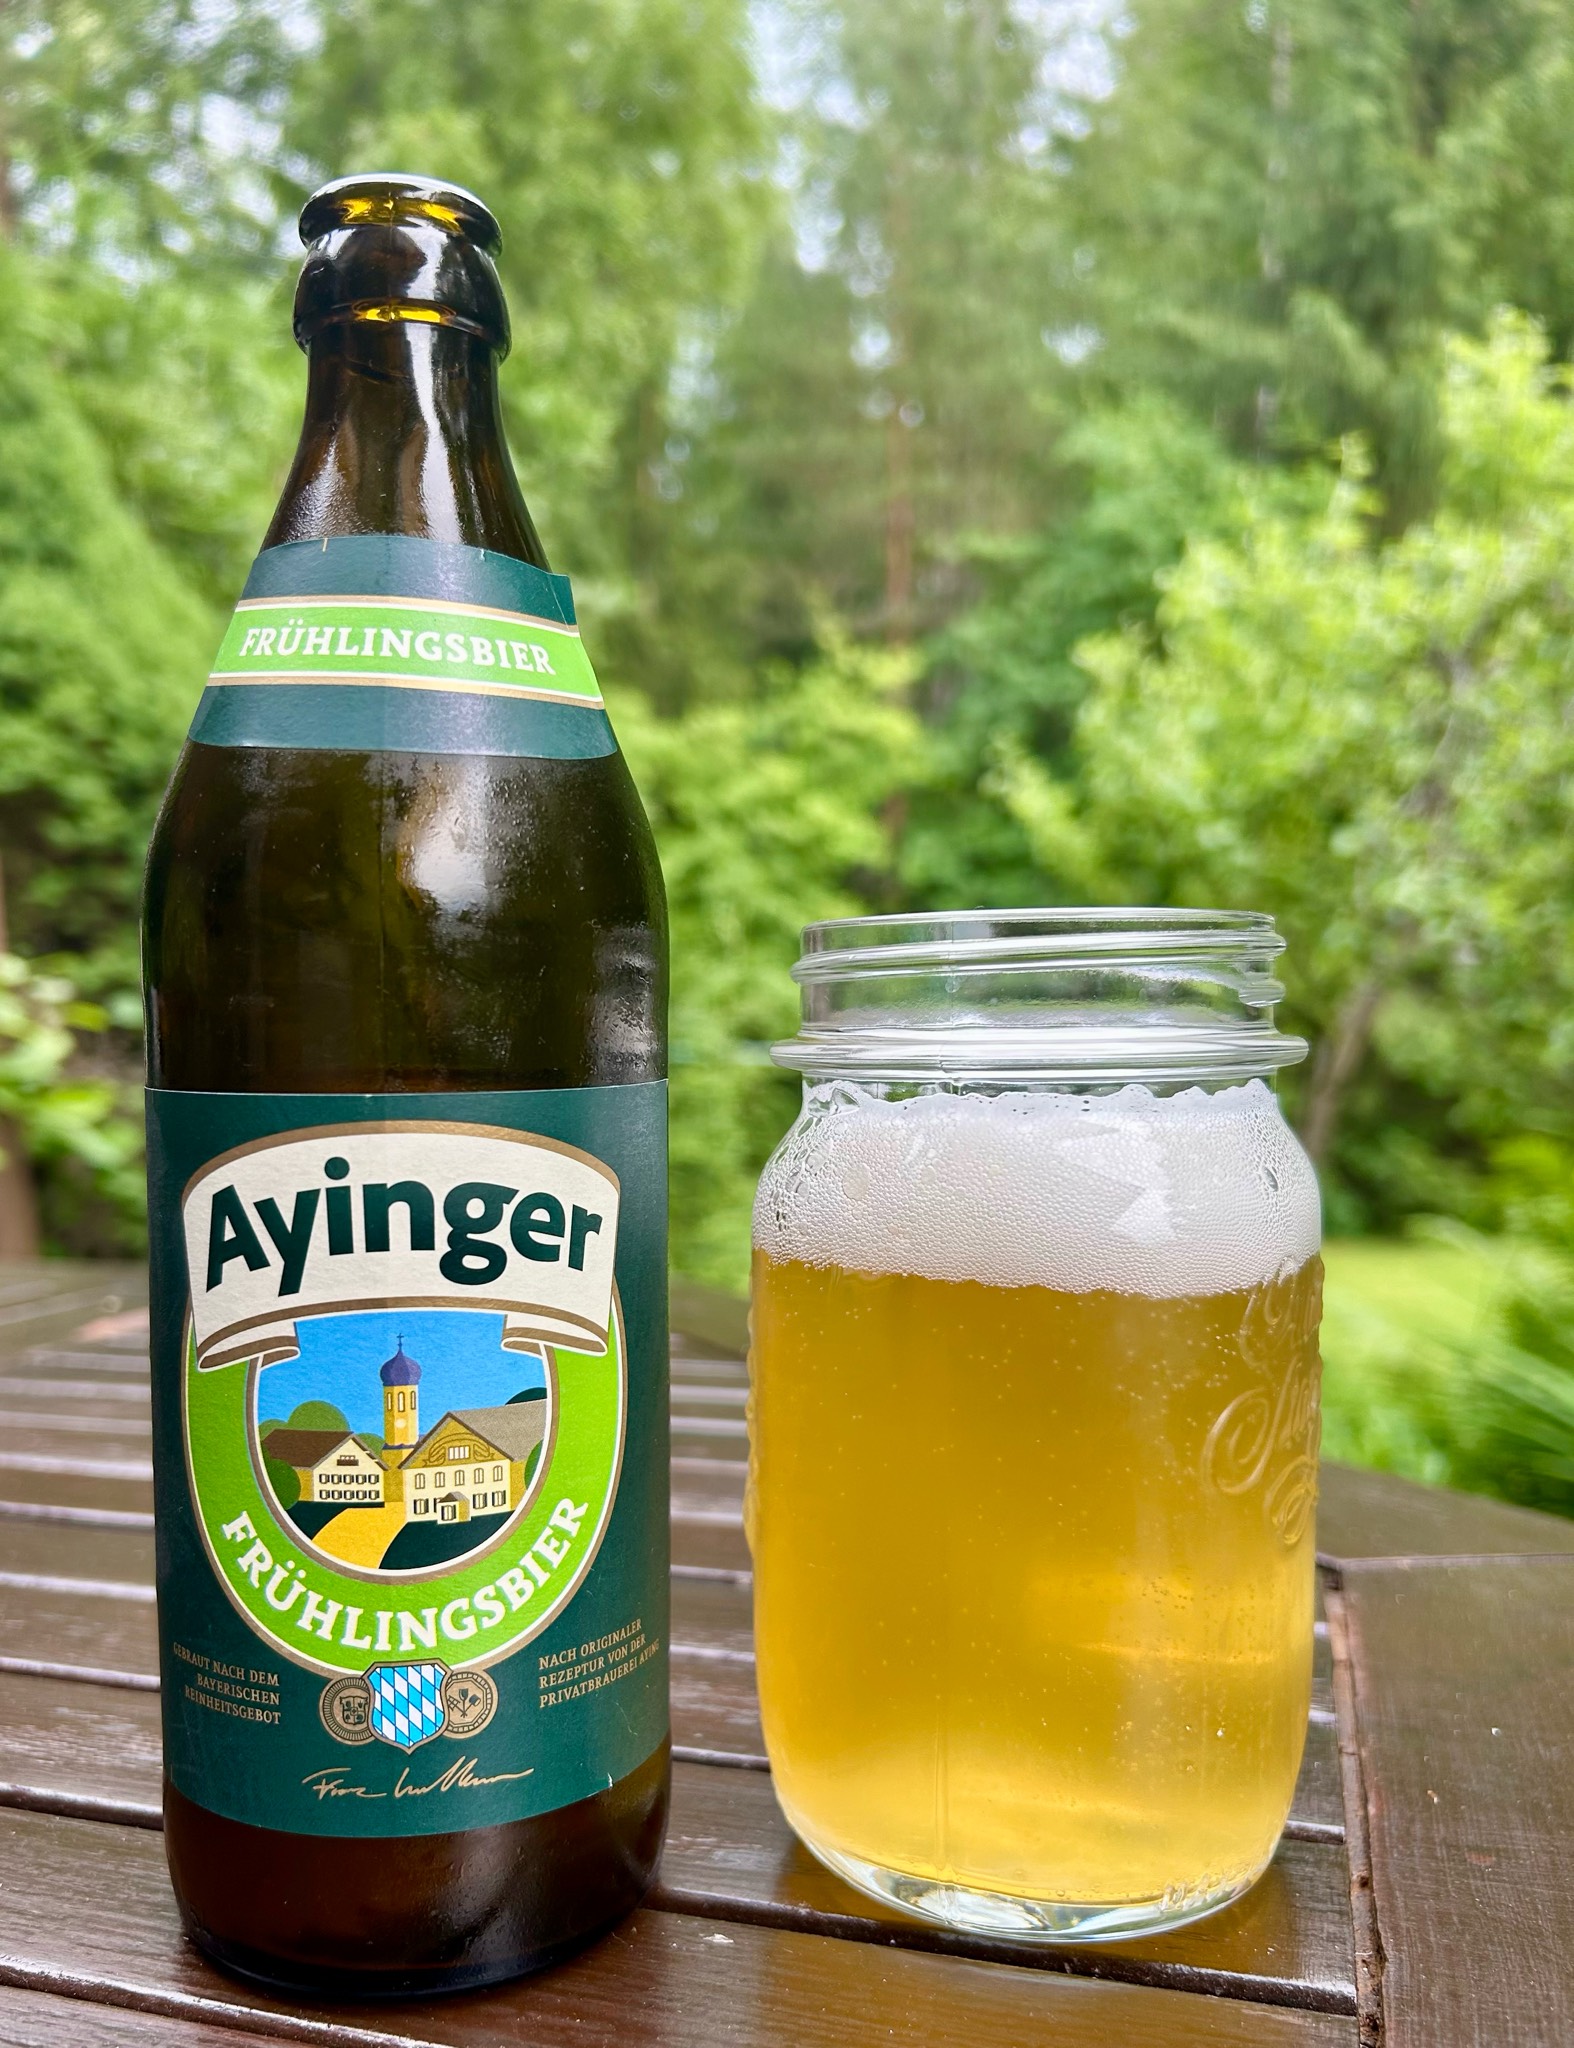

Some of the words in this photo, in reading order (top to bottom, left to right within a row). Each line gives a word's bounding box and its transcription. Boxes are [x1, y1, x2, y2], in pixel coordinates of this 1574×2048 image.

[238, 618, 557, 675] FRÜHLINGSBIER
[205, 1156, 604, 1297] Ayinger
[221, 1498, 589, 1652] FRÜHLINGSBIER
[173, 1641, 211, 1671] GEBRAUT
[213, 1661, 245, 1680] NACH
[249, 1669, 279, 1687] DEM
[538, 1647, 577, 1670] NACH
[580, 1618, 642, 1657] ORIGINALER
[538, 1656, 605, 1689] REZEPTUR
[607, 1643, 629, 1664] VON
[630, 1633, 646, 1653] DER
[184, 1685, 281, 1725] REINHEITSGEBOT
[197, 1673, 280, 1706] BAYERISCHEN
[538, 1658, 638, 1709] PRIVATBRAUEREI
